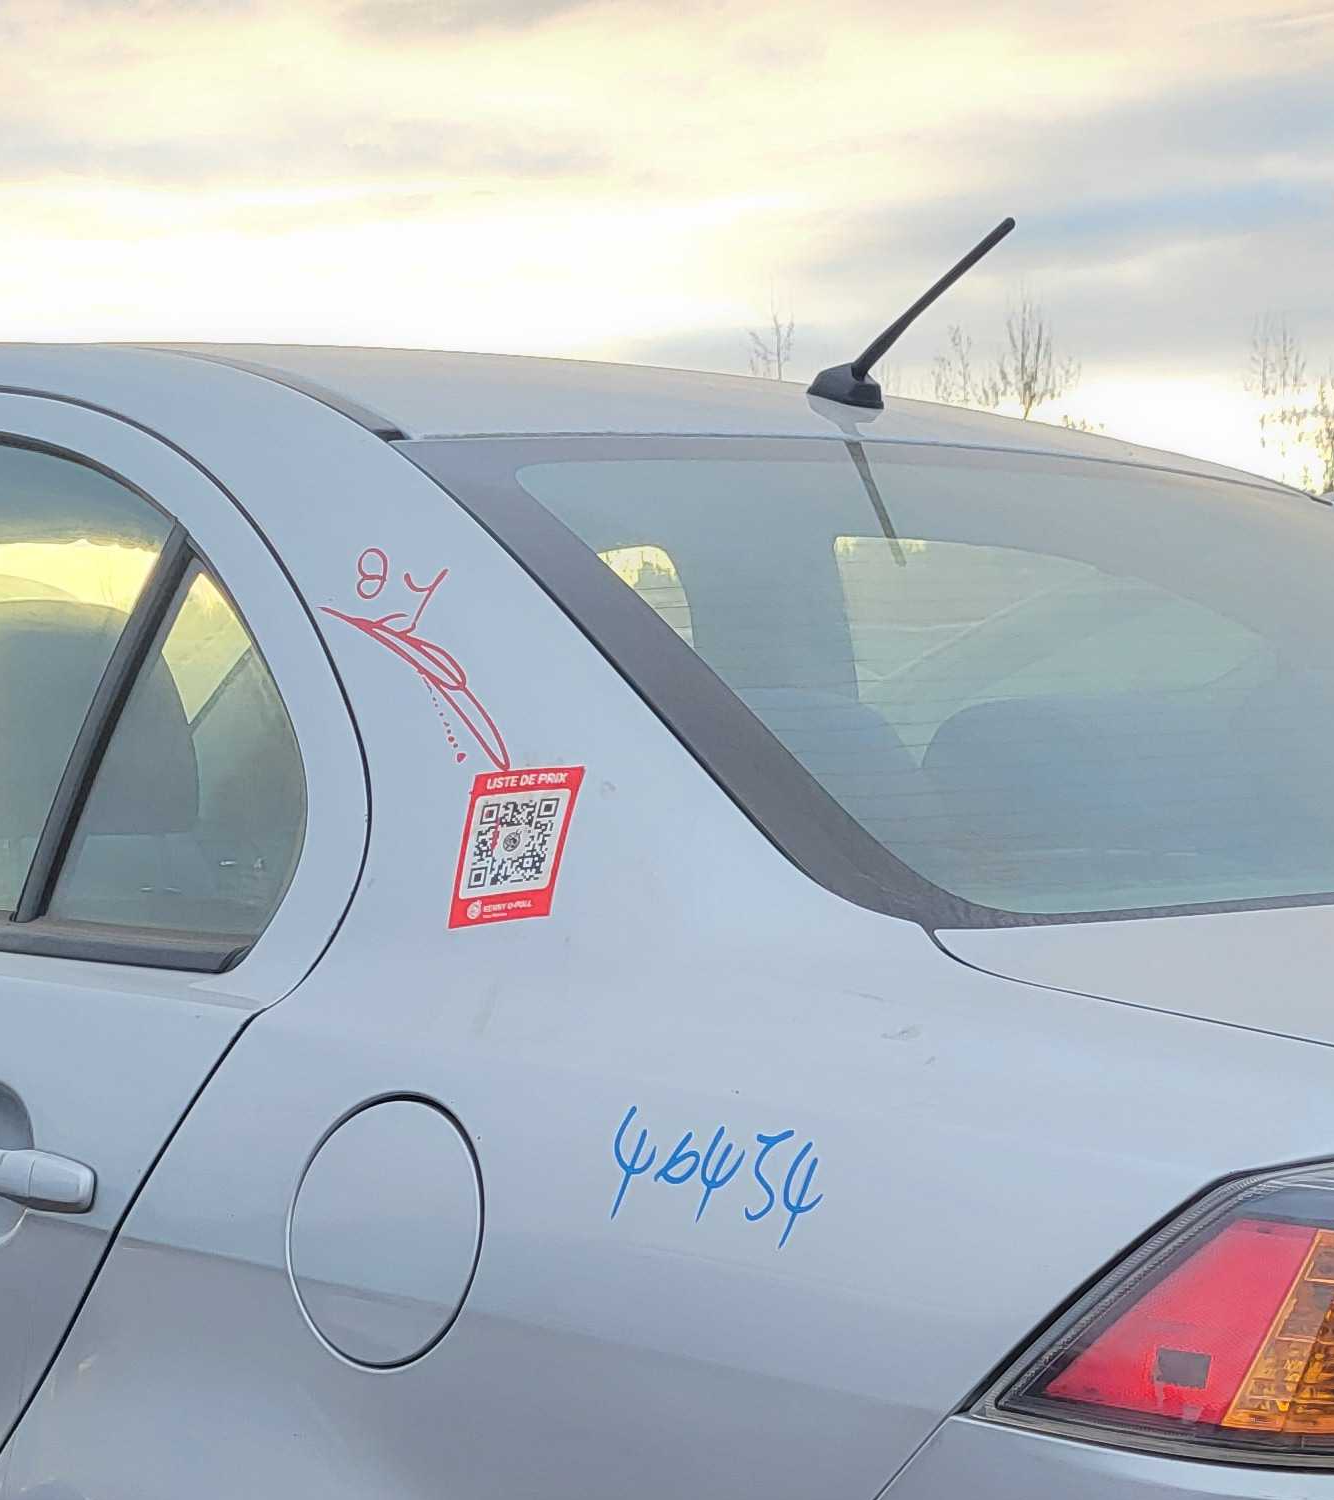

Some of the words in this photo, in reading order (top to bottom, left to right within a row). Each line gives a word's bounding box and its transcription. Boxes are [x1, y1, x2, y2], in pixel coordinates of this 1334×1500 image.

[486, 775, 518, 790] LISTE
[519, 773, 537, 787] DE
[537, 771, 569, 786] PRIX
[609, 1104, 824, 1250] 46454
